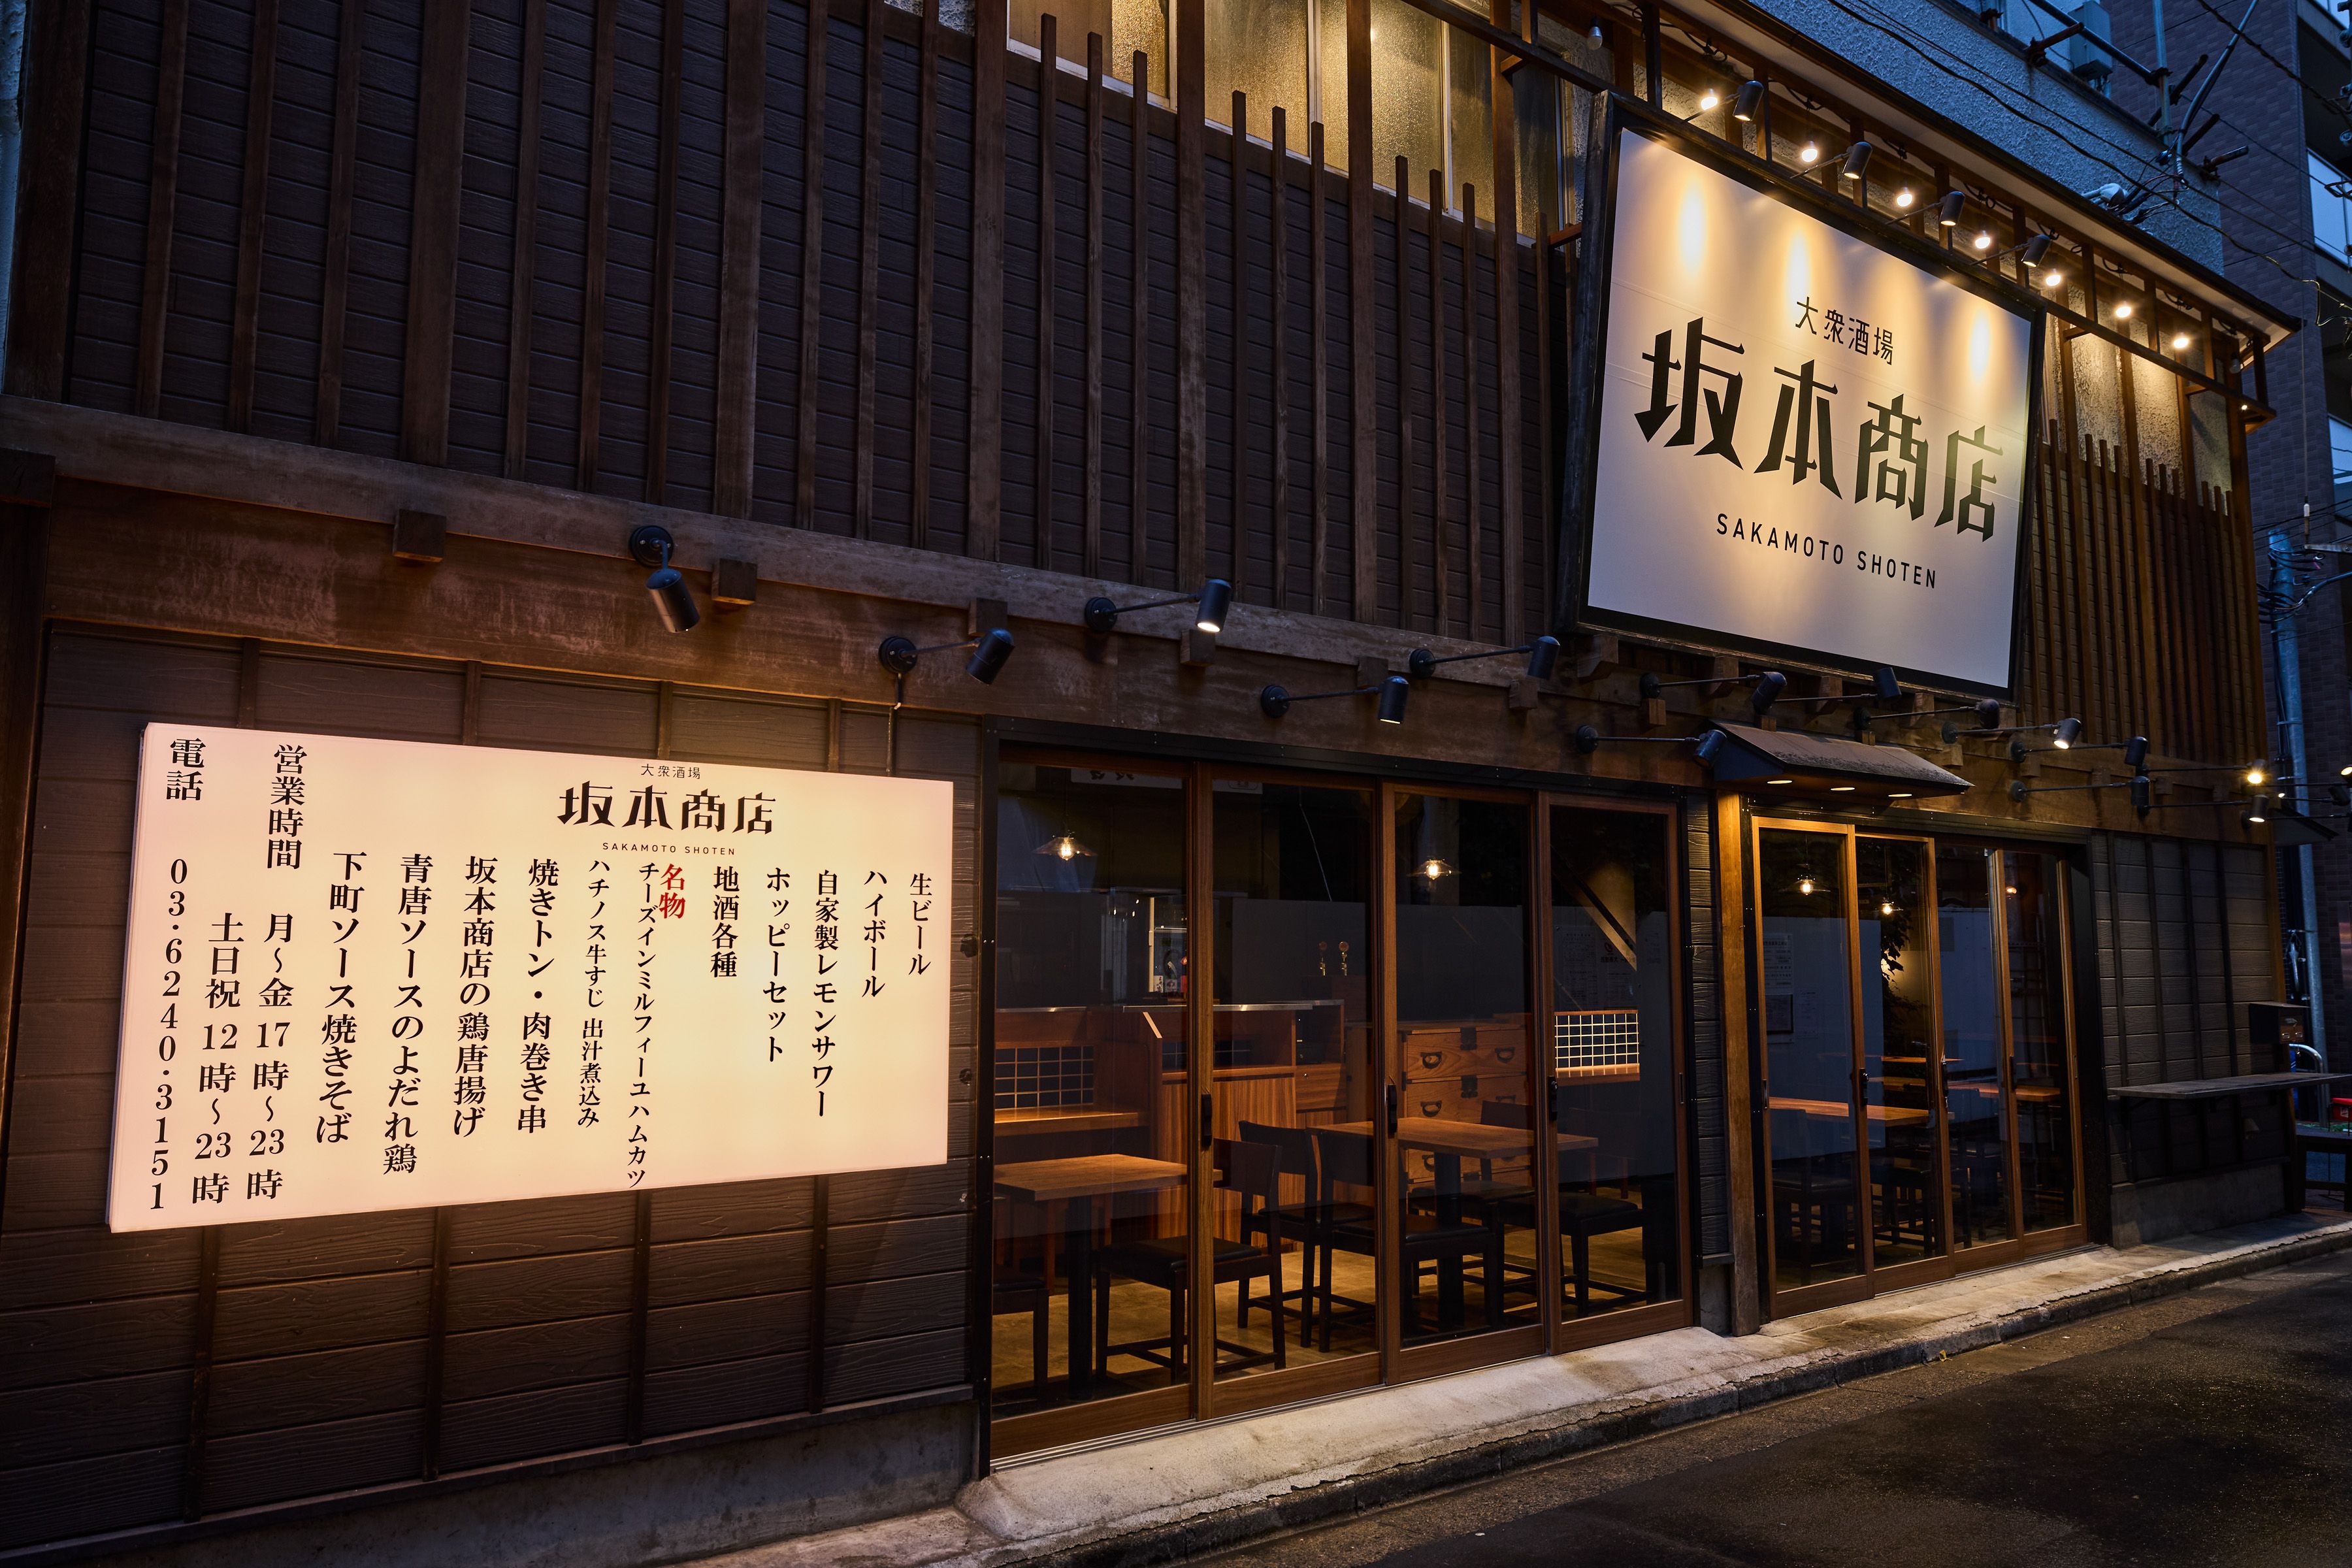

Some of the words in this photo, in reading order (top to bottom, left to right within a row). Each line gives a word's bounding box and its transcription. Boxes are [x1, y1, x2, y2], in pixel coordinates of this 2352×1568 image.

[1795, 296, 1893, 365] 大衆酒場
[1633, 316, 2004, 543] 坂本商店
[1716, 513, 1844, 564] SAKAMOTO
[1857, 550, 1936, 589] SHOTEN
[166, 738, 206, 801] 電話
[267, 744, 308, 870] 営業時間
[557, 780, 776, 835] 坂本商店
[640, 763, 700, 779] 大衆酒場
[602, 842, 676, 853] SAKAMOTO
[685, 846, 734, 855] SHOTEN
[659, 863, 686, 919] 名物
[585, 860, 610, 1008] ハチノス牛すじ
[710, 866, 740, 978] 地酒各種
[762, 867, 791, 1062] ホッピーセット
[862, 870, 887, 998] ハイボール
[908, 873, 932, 975] 生ビール
[316, 851, 367, 1143] 下町ソース焼きそば
[383, 853, 434, 1175] 青唐ソースのよだれ鶏
[453, 855, 498, 1137] 坂本商店の鶏唐揚げ
[517, 858, 560, 1134] 焼きトン・肉巻き串
[627, 862, 659, 1188] チーズインミルフィーユハムカツ
[811, 869, 840, 1117] 自家製レモンサワー
[578, 1018, 603, 1128] 出汁煮込み
